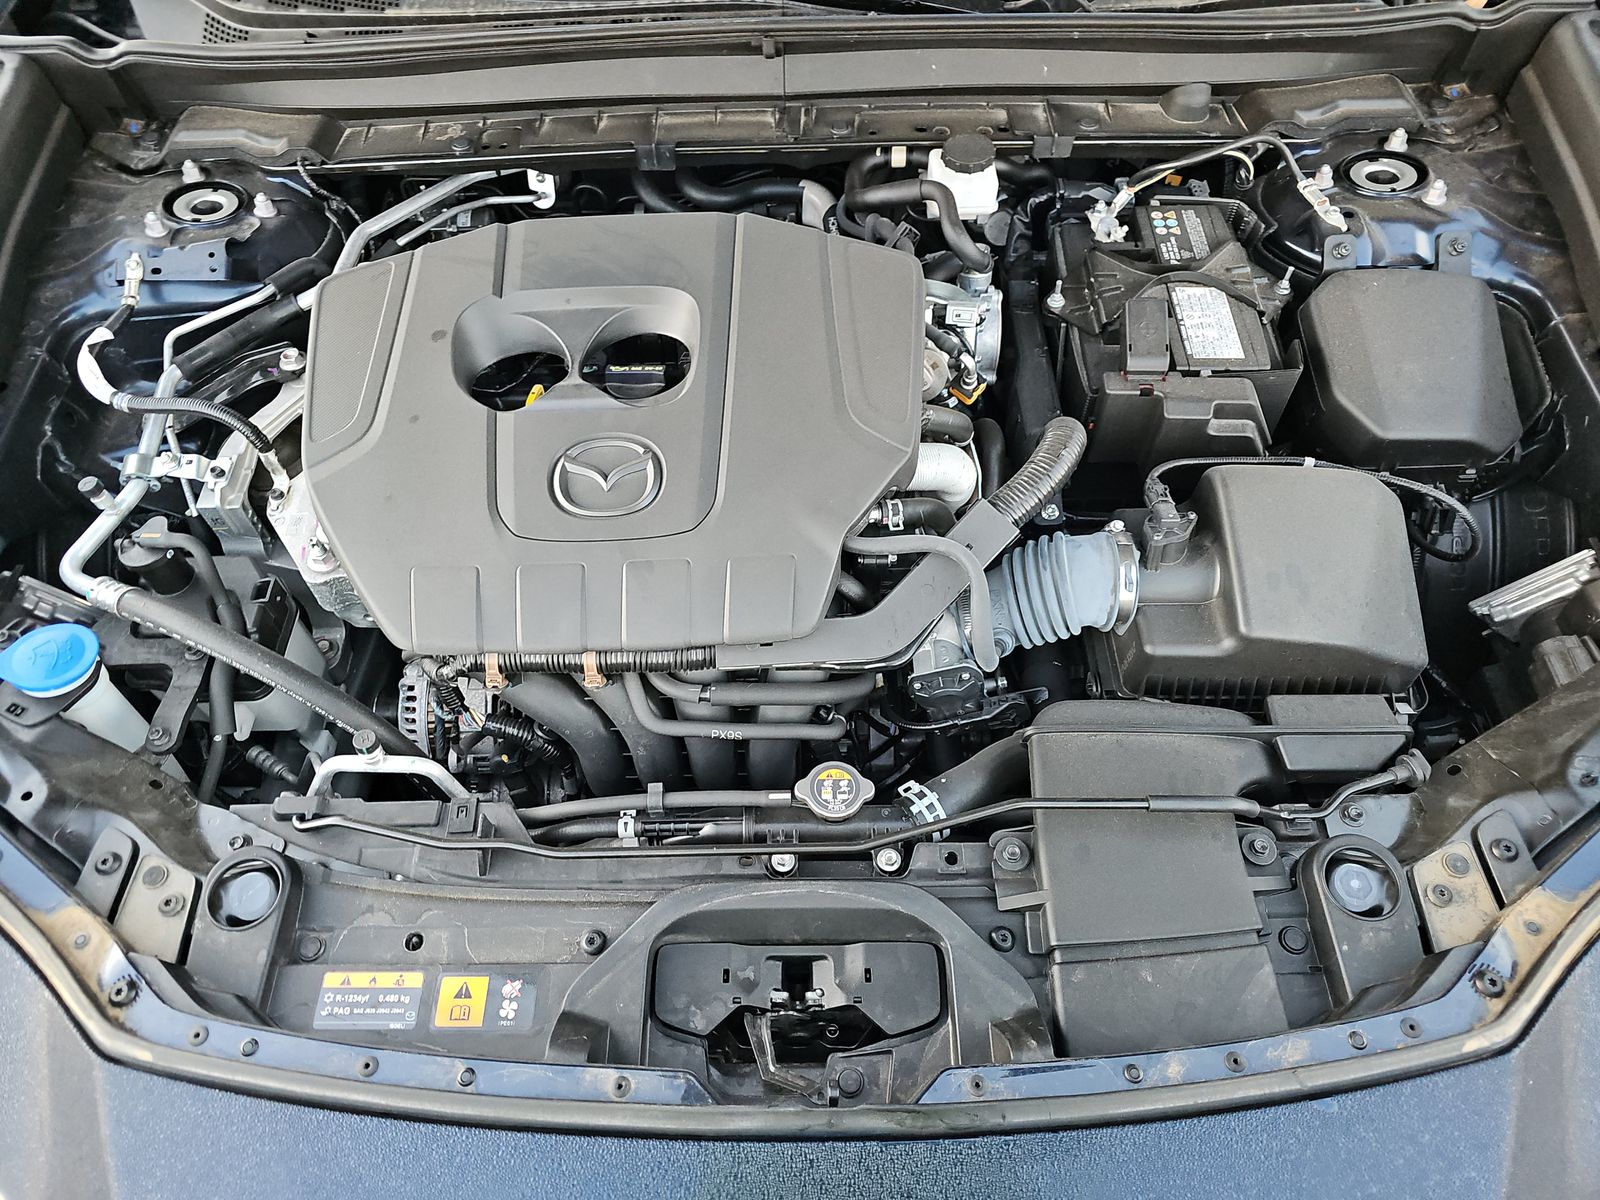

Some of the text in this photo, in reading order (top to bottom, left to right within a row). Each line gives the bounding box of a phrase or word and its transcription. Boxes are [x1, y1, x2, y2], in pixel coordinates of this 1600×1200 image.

[335, 994, 370, 1004] R-1234yf
[399, 994, 411, 1004] kg
[332, 1007, 351, 1015] PAG
